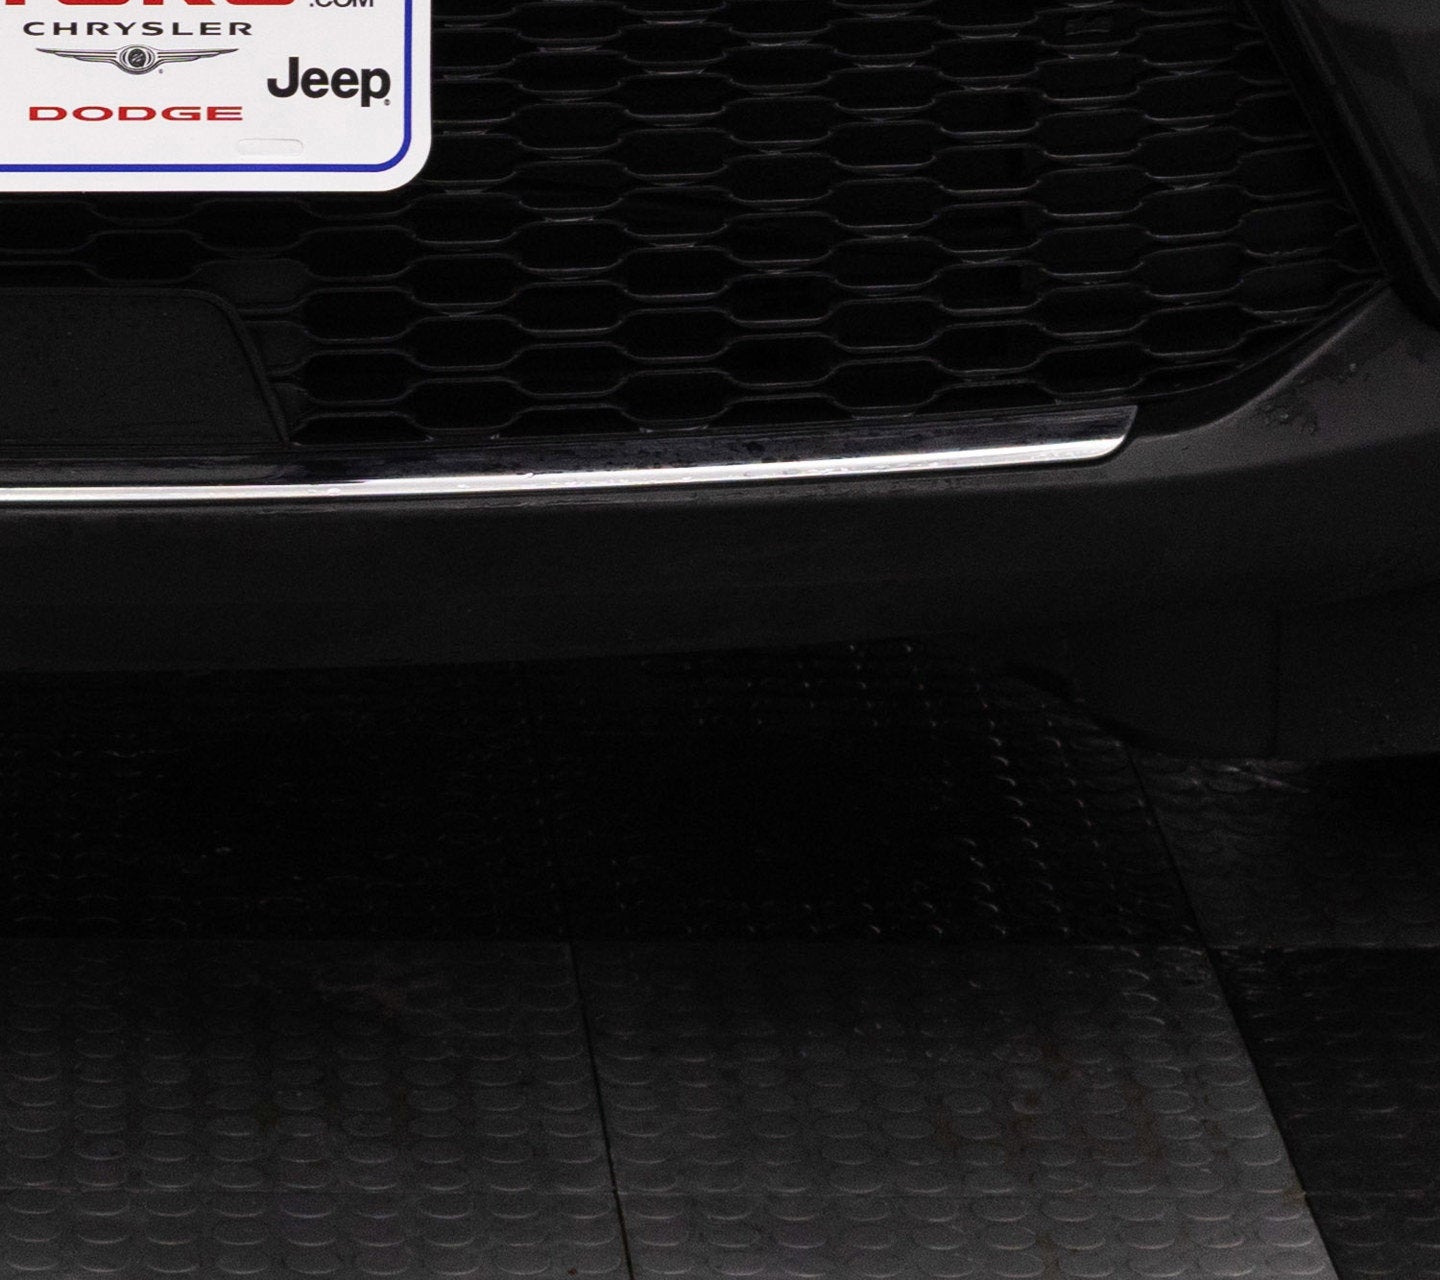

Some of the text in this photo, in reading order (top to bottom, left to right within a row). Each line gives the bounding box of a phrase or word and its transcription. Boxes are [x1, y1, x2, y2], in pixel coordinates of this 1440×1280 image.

[23, 21, 253, 37] CHRYSLER
[267, 57, 391, 108] Jeep
[29, 107, 243, 121] DODGE
